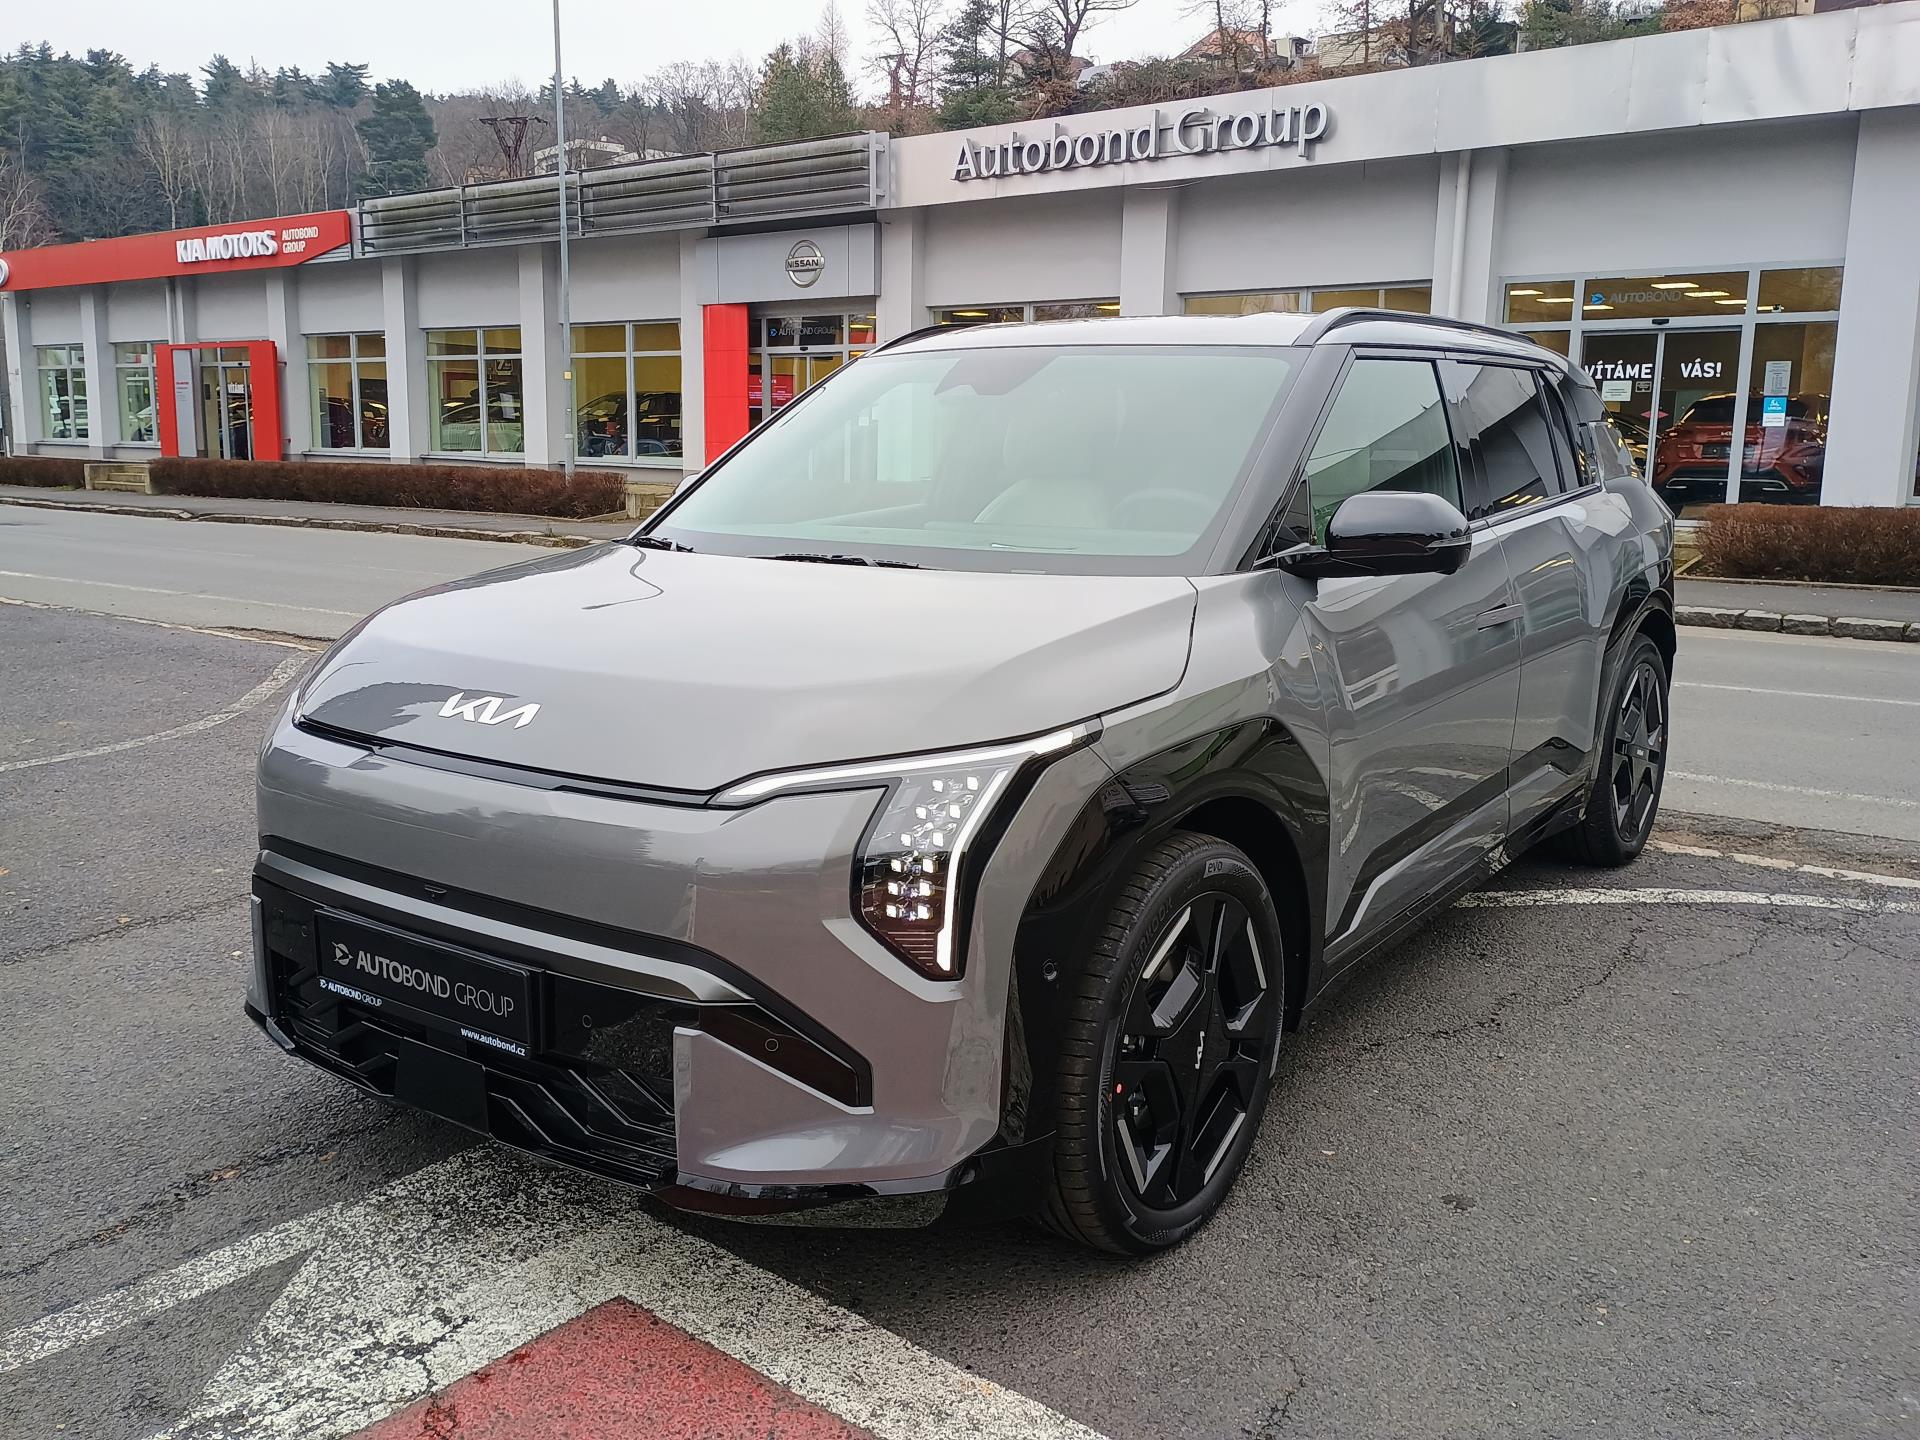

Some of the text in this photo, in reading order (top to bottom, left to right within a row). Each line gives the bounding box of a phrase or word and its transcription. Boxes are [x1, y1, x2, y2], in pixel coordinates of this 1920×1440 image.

[954, 100, 1329, 181] Autobond Group
[281, 226, 319, 241] AUTOBOND
[176, 230, 278, 263] KIA MOTORS
[282, 240, 306, 254] GROUP
[787, 258, 819, 269] NISSAN
[1609, 290, 1682, 304] AUTOBOND
[1584, 357, 1722, 380] VÍTÁME VÁS!
[327, 981, 383, 1007] AUTOBOND GROUP
[356, 950, 514, 1018] AUTOBOND GROUP
[460, 1027, 526, 1057] www.autobond.cz
